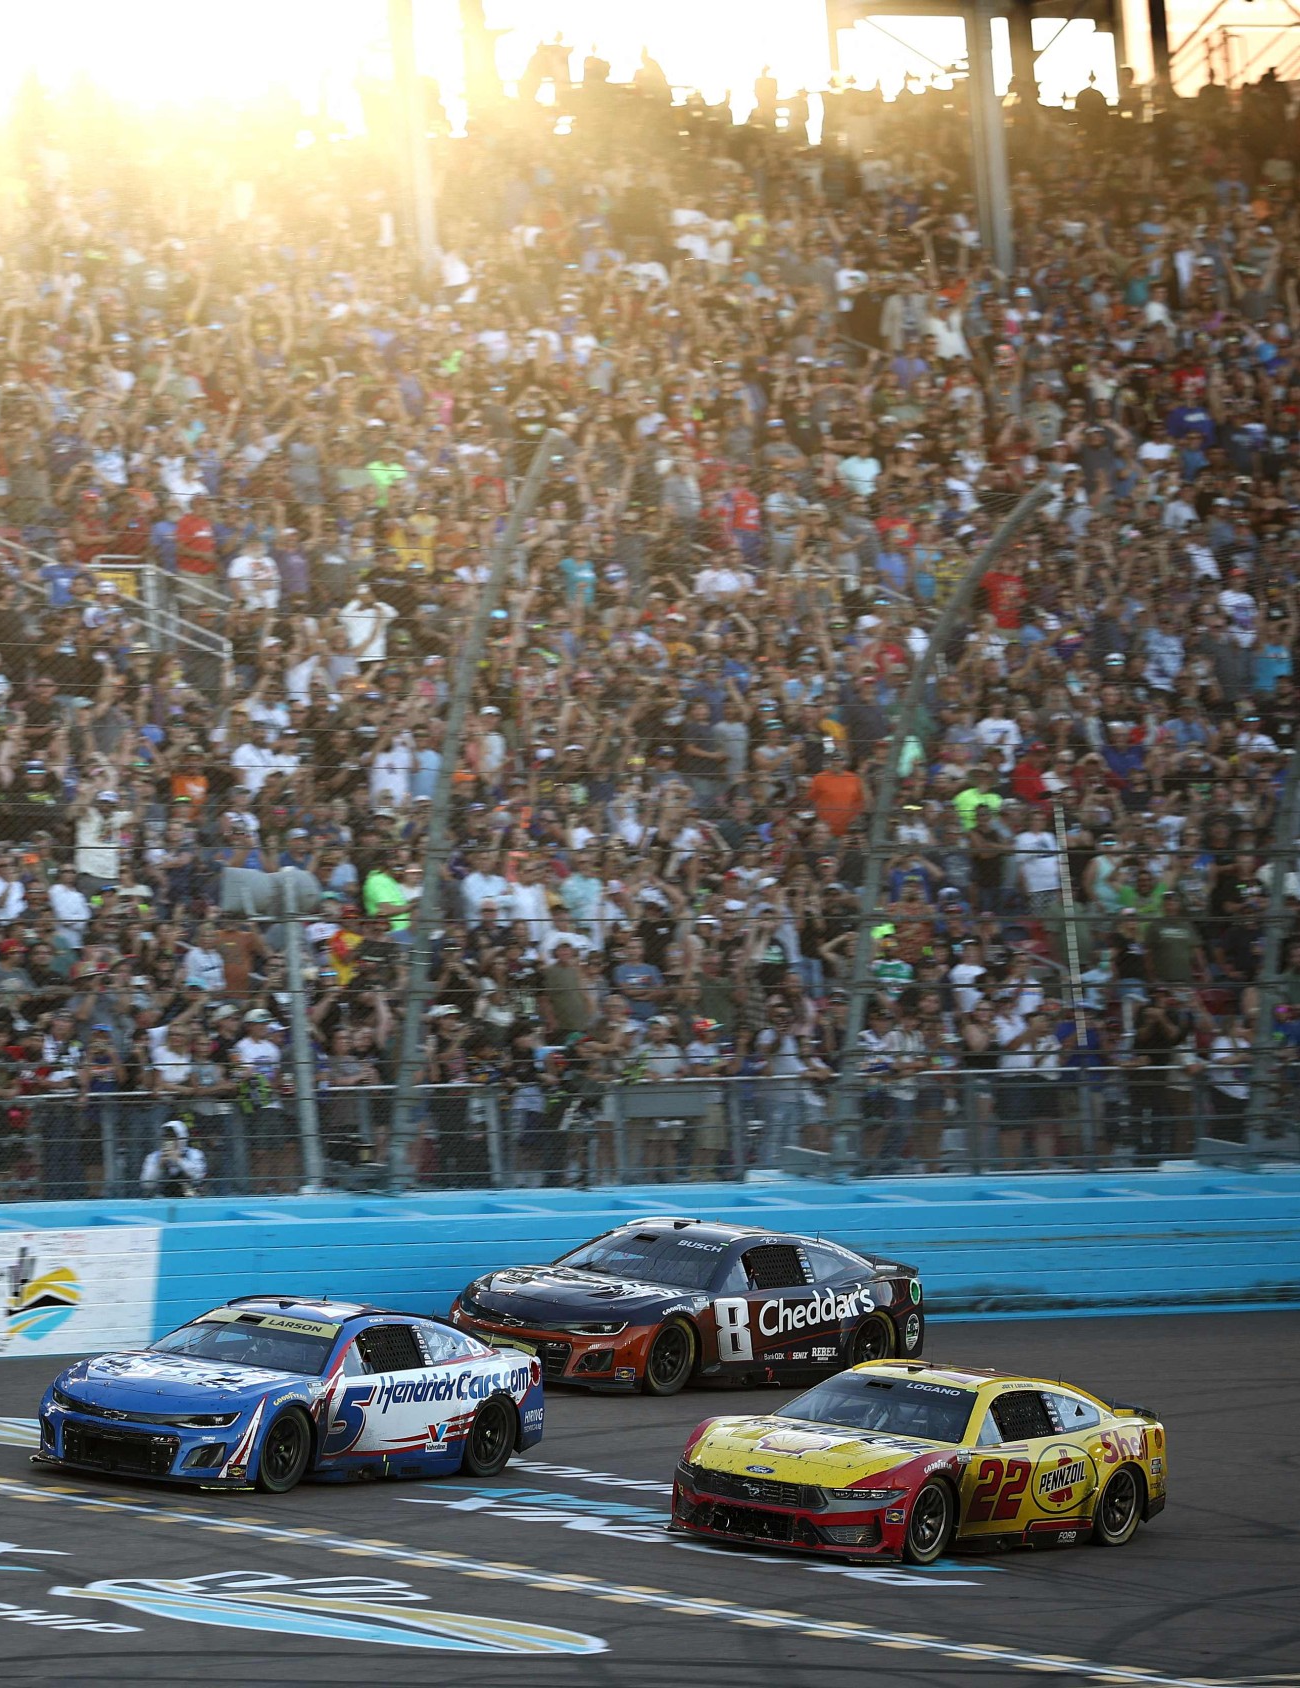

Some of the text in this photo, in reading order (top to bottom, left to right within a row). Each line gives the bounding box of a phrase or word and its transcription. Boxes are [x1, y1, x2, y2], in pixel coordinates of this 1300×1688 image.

[677, 1239, 723, 1253] BUSCH
[268, 1319, 323, 1333] LARSON
[758, 1283, 876, 1337] Cheddar's
[714, 1297, 754, 1362] 8
[906, 1382, 961, 1396] LOGANO
[322, 1385, 377, 1456] 5
[1101, 1426, 1148, 1464] Shell
[965, 1457, 1031, 1522] 22
[1038, 1461, 1087, 1494] PENNZOIL
[1058, 1531, 1077, 1540] FORD
